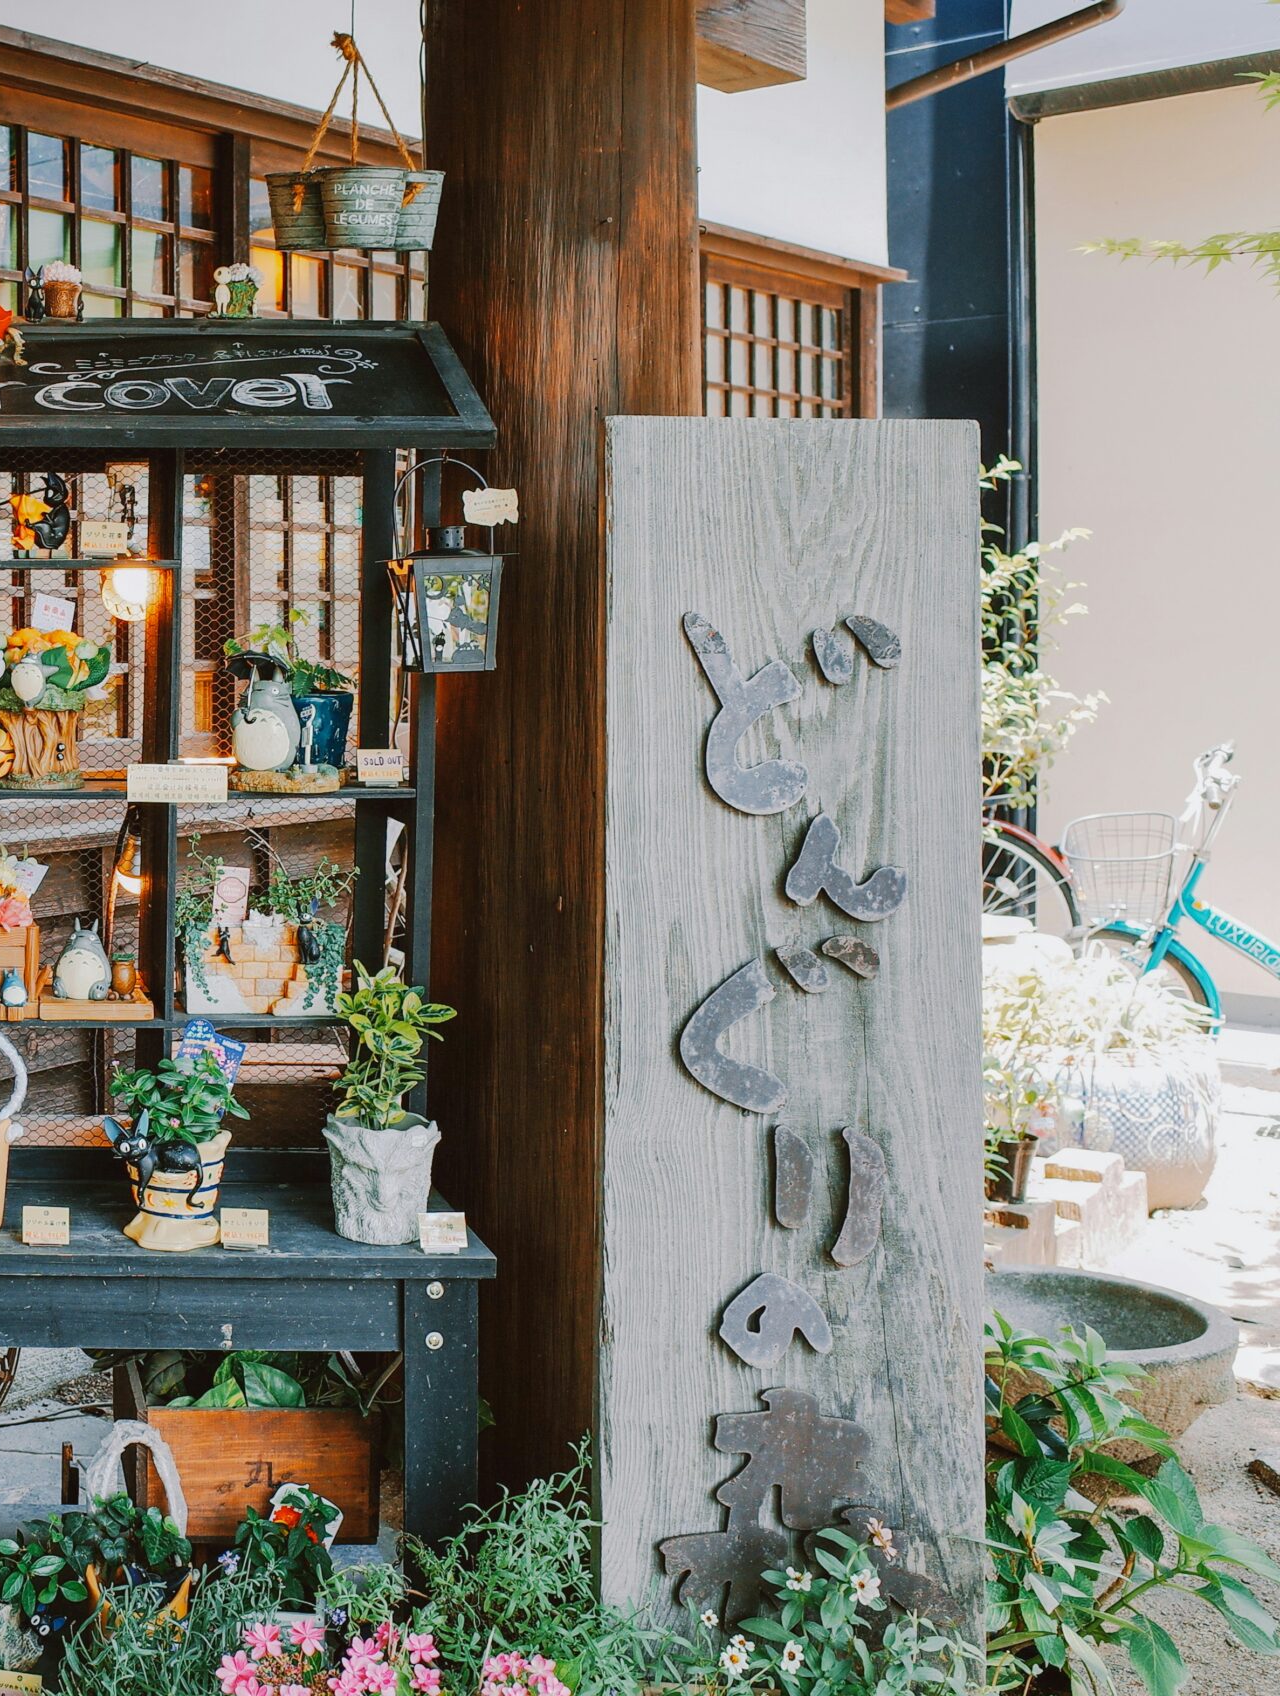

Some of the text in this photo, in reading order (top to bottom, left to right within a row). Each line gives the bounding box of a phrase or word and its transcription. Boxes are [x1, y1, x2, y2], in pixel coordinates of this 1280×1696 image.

[334, 184, 396, 196] PLANCHE
[355, 199, 374, 211] DE
[334, 211, 394, 225] LÉGUMES
[35, 373, 352, 411] cover
[388, 755, 404, 765] OUT
